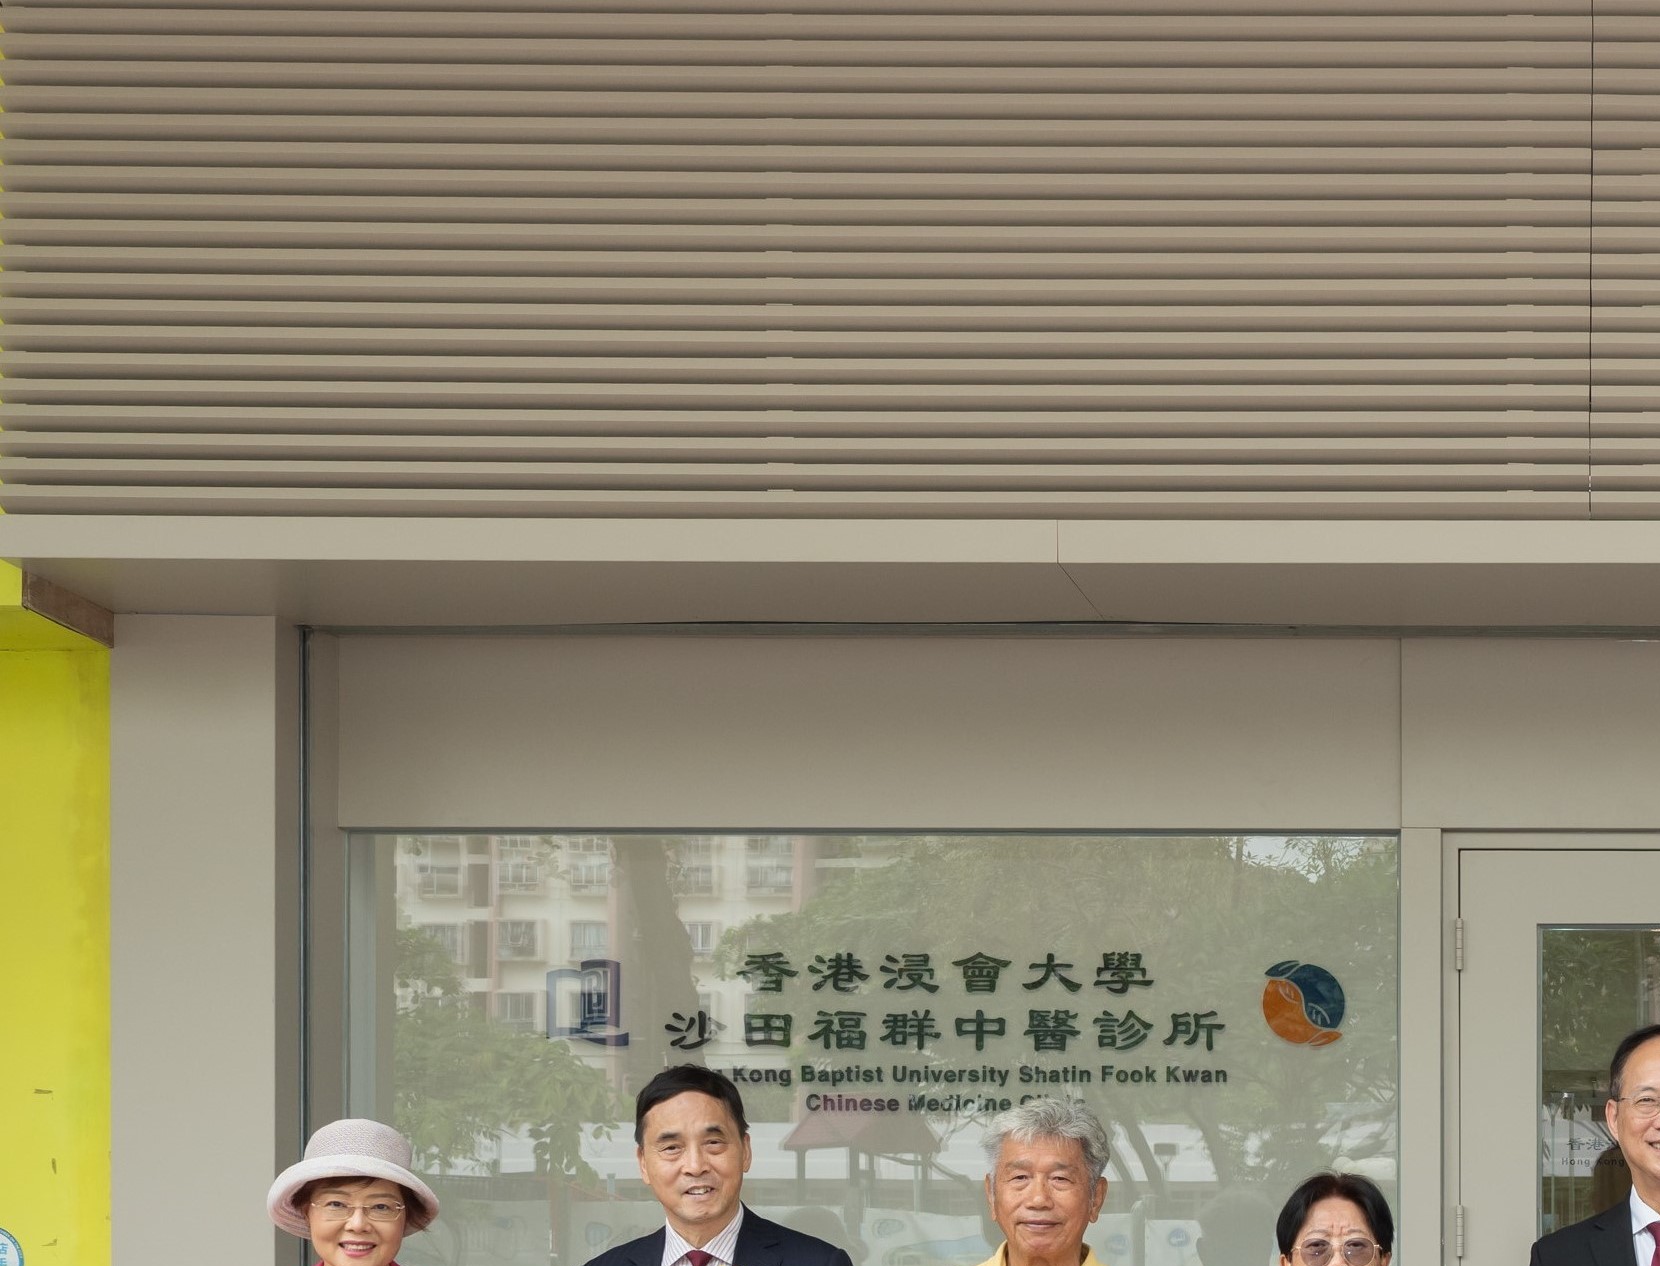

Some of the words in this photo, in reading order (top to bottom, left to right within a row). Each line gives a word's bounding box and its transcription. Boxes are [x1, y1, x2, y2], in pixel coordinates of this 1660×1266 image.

[737, 951, 1155, 994] 香港浸會大學
[664, 1008, 1226, 1052] 沙田福群中醫診所
[733, 1065, 792, 1086] Kong
[800, 1065, 883, 1086] Baptist
[892, 1065, 1009, 1087] University
[1019, 1065, 1091, 1083] Shatin
[1101, 1065, 1157, 1083] Fook
[1165, 1065, 1228, 1083] Kwan
[806, 1093, 900, 1112] Chinese
[908, 1094, 1012, 1112] Medicine
[1561, 1157, 1590, 1168] Hong
